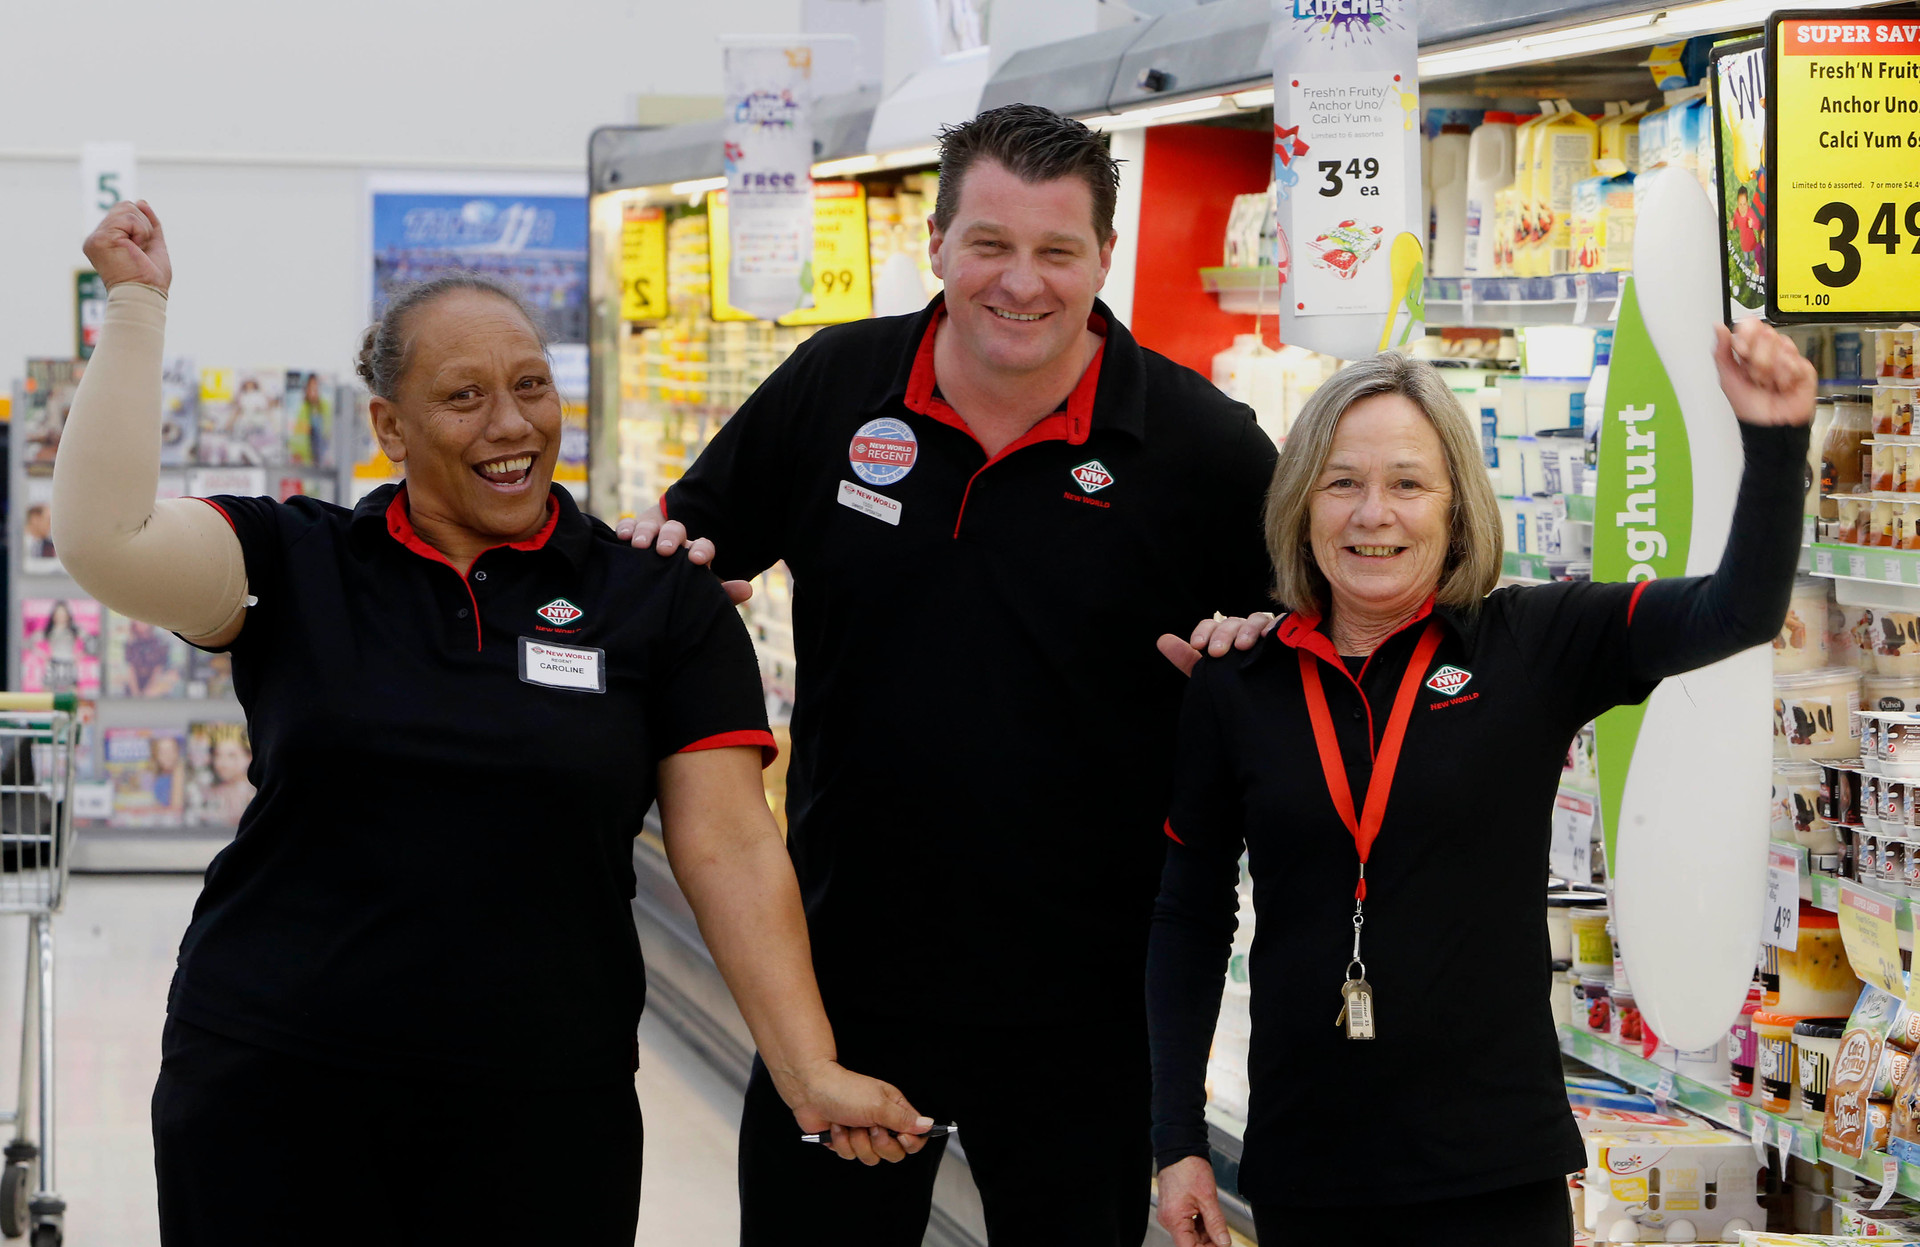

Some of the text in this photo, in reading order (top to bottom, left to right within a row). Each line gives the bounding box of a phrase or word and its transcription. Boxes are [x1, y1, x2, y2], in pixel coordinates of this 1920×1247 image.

[1797, 25, 1920, 43] SUPER SAV
[1810, 61, 1920, 84] Fresh'N Fruit
[1727, 50, 1765, 119] WI
[1303, 87, 1346, 98] Fresh'n
[1309, 98, 1385, 111] Anchor Uno/
[1820, 95, 1920, 113] Anchor Uno
[1312, 113, 1340, 124] Calci
[1344, 113, 1371, 123] Yum
[1819, 130, 1920, 148] Calci Yum 6
[97, 173, 121, 210] 5
[1360, 184, 1380, 196] ea
[1792, 181, 1818, 189] Limited
[1827, 181, 1832, 189] 6
[1870, 181, 1875, 189] 7
[1804, 294, 1830, 306] 1.00
[887, 443, 912, 453] WORLD
[868, 449, 911, 462] REGENT
[1616, 403, 1668, 583] oghurt
[856, 489, 872, 500] NEW
[873, 495, 898, 511] WORLD
[545, 649, 593, 661] NEW WORLD
[551, 657, 572, 665] REGENT
[539, 662, 585, 675] CAROLINE
[1450, 692, 1480, 705] WORLD
